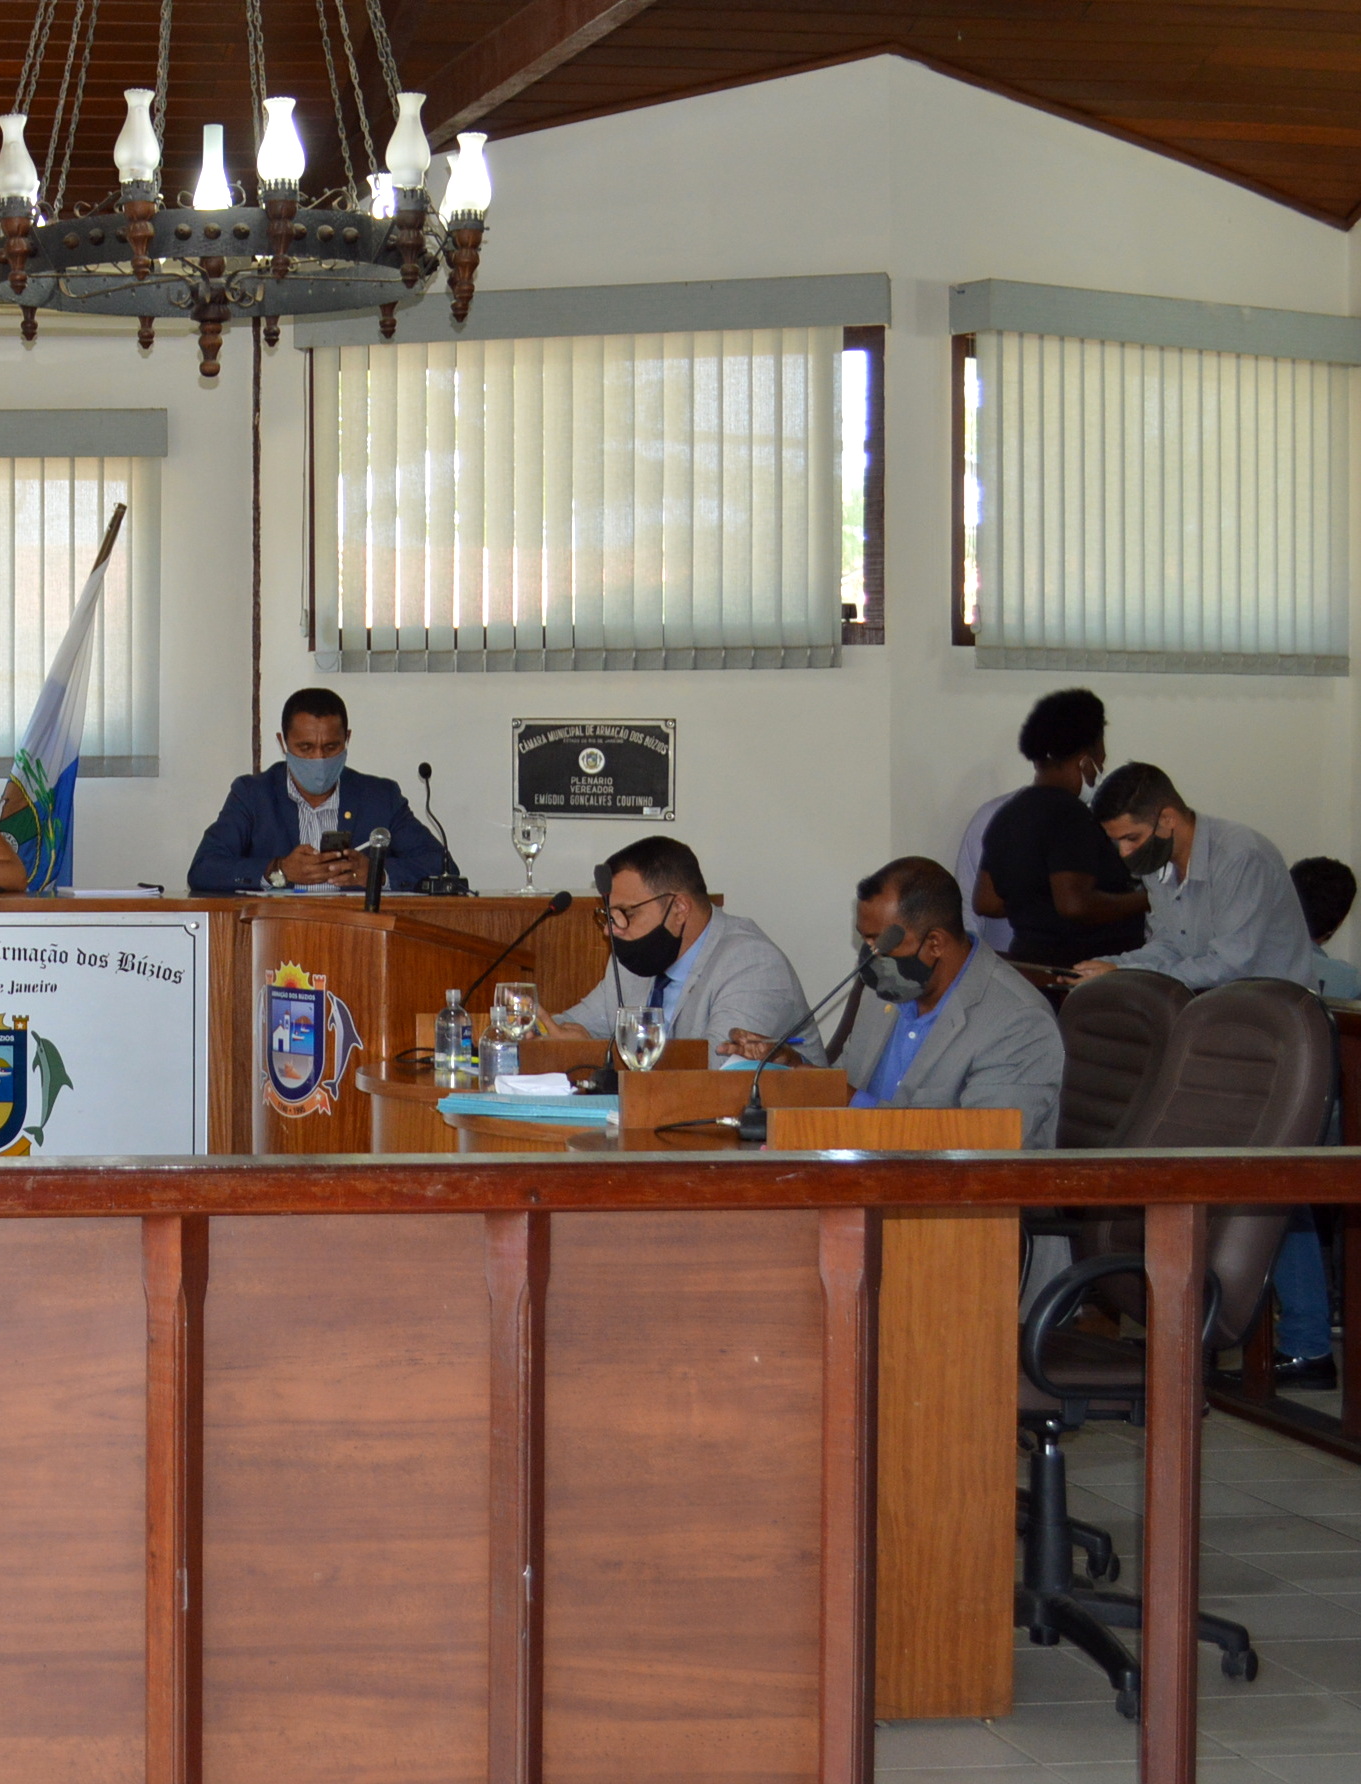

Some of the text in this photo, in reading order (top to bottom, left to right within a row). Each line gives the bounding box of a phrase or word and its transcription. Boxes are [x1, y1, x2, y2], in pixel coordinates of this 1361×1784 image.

[519, 725, 668, 755] CÂMARA MUNICIPAL DE ARMAÇÃO DOS BÚZIOS
[570, 775, 613, 785] PLENÁRIO
[570, 785, 614, 794] VEREADOR
[534, 793, 653, 807] EMÍGDIO GONÇALVES COUTINHO
[76, 947, 110, 969] dos
[115, 951, 186, 985] Búzios
[7, 980, 58, 995] Janeiro
